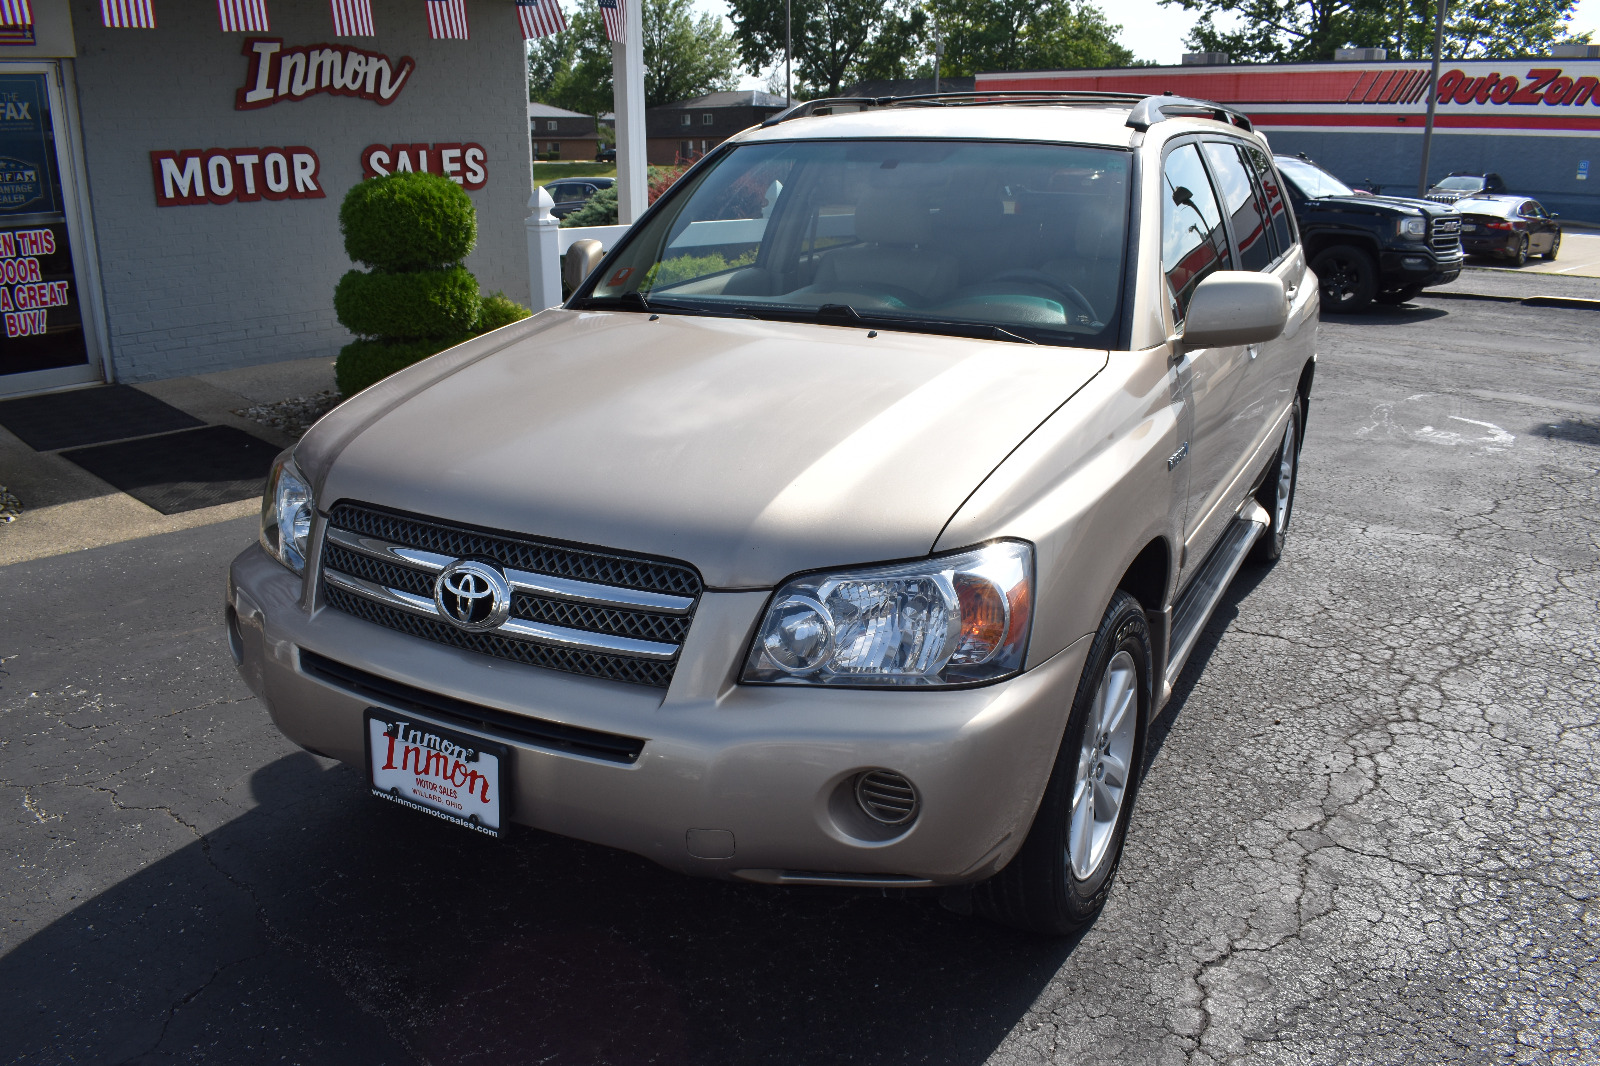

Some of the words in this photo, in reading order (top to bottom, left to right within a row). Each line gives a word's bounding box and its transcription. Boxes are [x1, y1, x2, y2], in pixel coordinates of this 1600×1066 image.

[246, 42, 411, 102] Inmon
[159, 152, 318, 199] MOTOR
[369, 147, 485, 184] SALES
[15, 229, 56, 256] THIS
[0, 286, 14, 312] A
[15, 281, 68, 310] GREAT
[5, 309, 47, 338] BUY!
[395, 721, 470, 763] Inmon
[381, 731, 491, 804] Inmon
[415, 777, 438, 793] MOTOR
[438, 784, 458, 799] SALES
[445, 799, 463, 811] OHIO
[371, 788, 498, 838] www.inmonmotorsales.com
